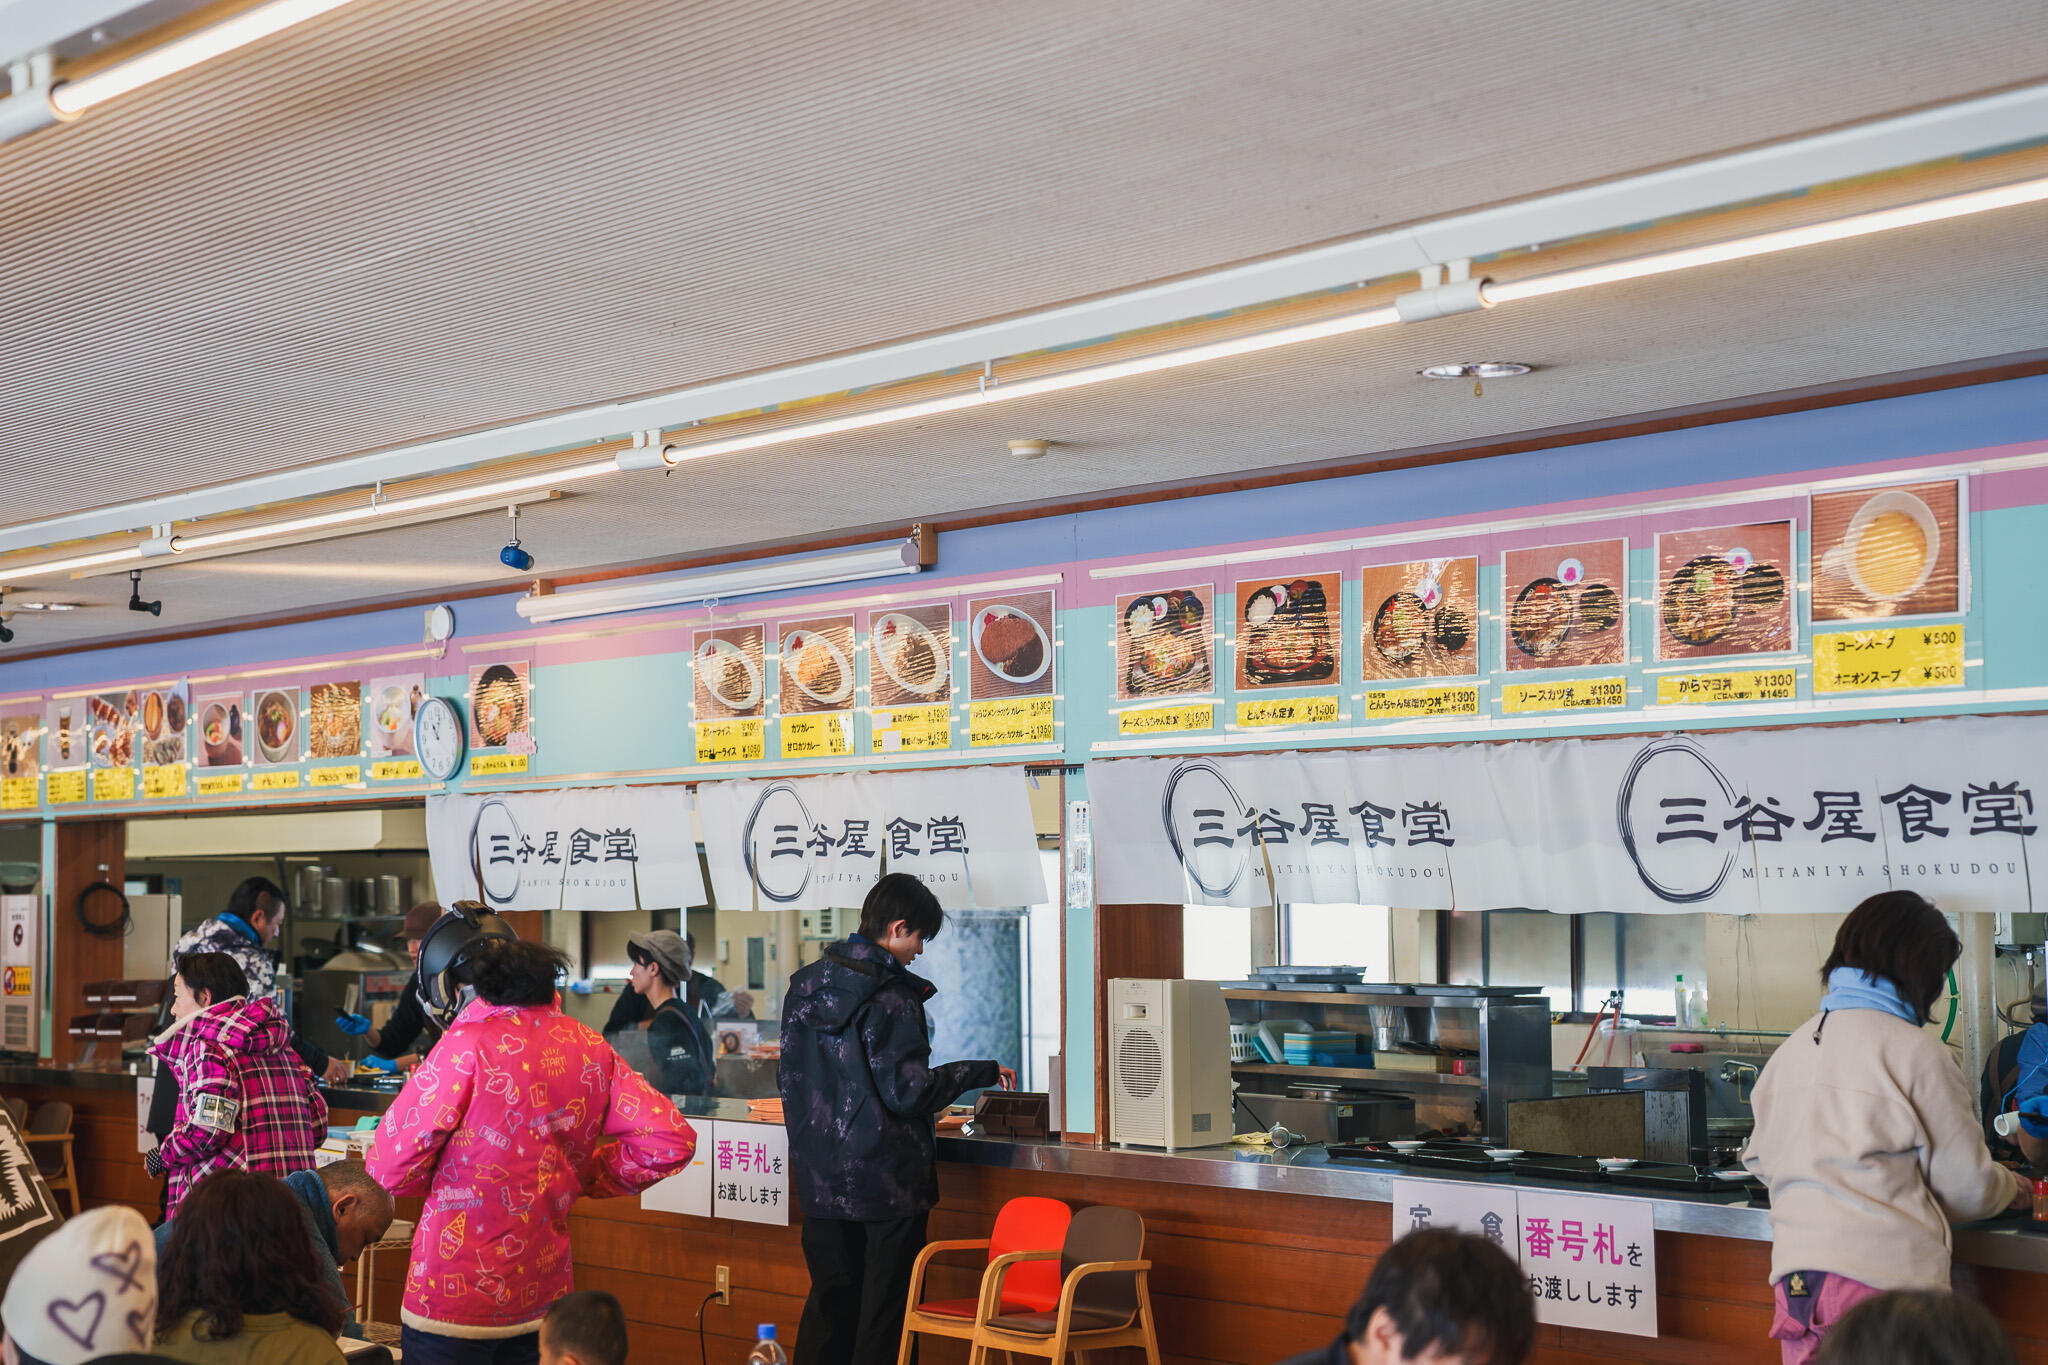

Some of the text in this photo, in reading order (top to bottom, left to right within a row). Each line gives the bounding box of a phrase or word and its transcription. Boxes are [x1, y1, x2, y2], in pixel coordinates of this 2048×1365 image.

[1837, 631, 1957, 652] コーンスープ ¥500
[1679, 673, 1793, 693] からマヨ丼 ¥1300
[1833, 665, 1957, 685] オニオンスープ ¥500
[1443, 690, 1476, 703] ¥1300
[1519, 683, 1623, 703] ソースカツ丼 ¥1300
[1760, 689, 1789, 699] ¥1450
[1193, 800, 1456, 849] 三谷屋食堂
[1656, 781, 2038, 845] 三谷屋食堂
[488, 827, 640, 866] 三谷屋食堂
[770, 815, 970, 861] 三谷屋食堂
[1741, 862, 2017, 879] MITANIYA SHOKUDOU
[717, 1140, 783, 1175] 番号札を
[717, 1181, 782, 1207] お渡しします
[1525, 1217, 1643, 1267] 番号札を
[1527, 1272, 1643, 1310] お渡しします
